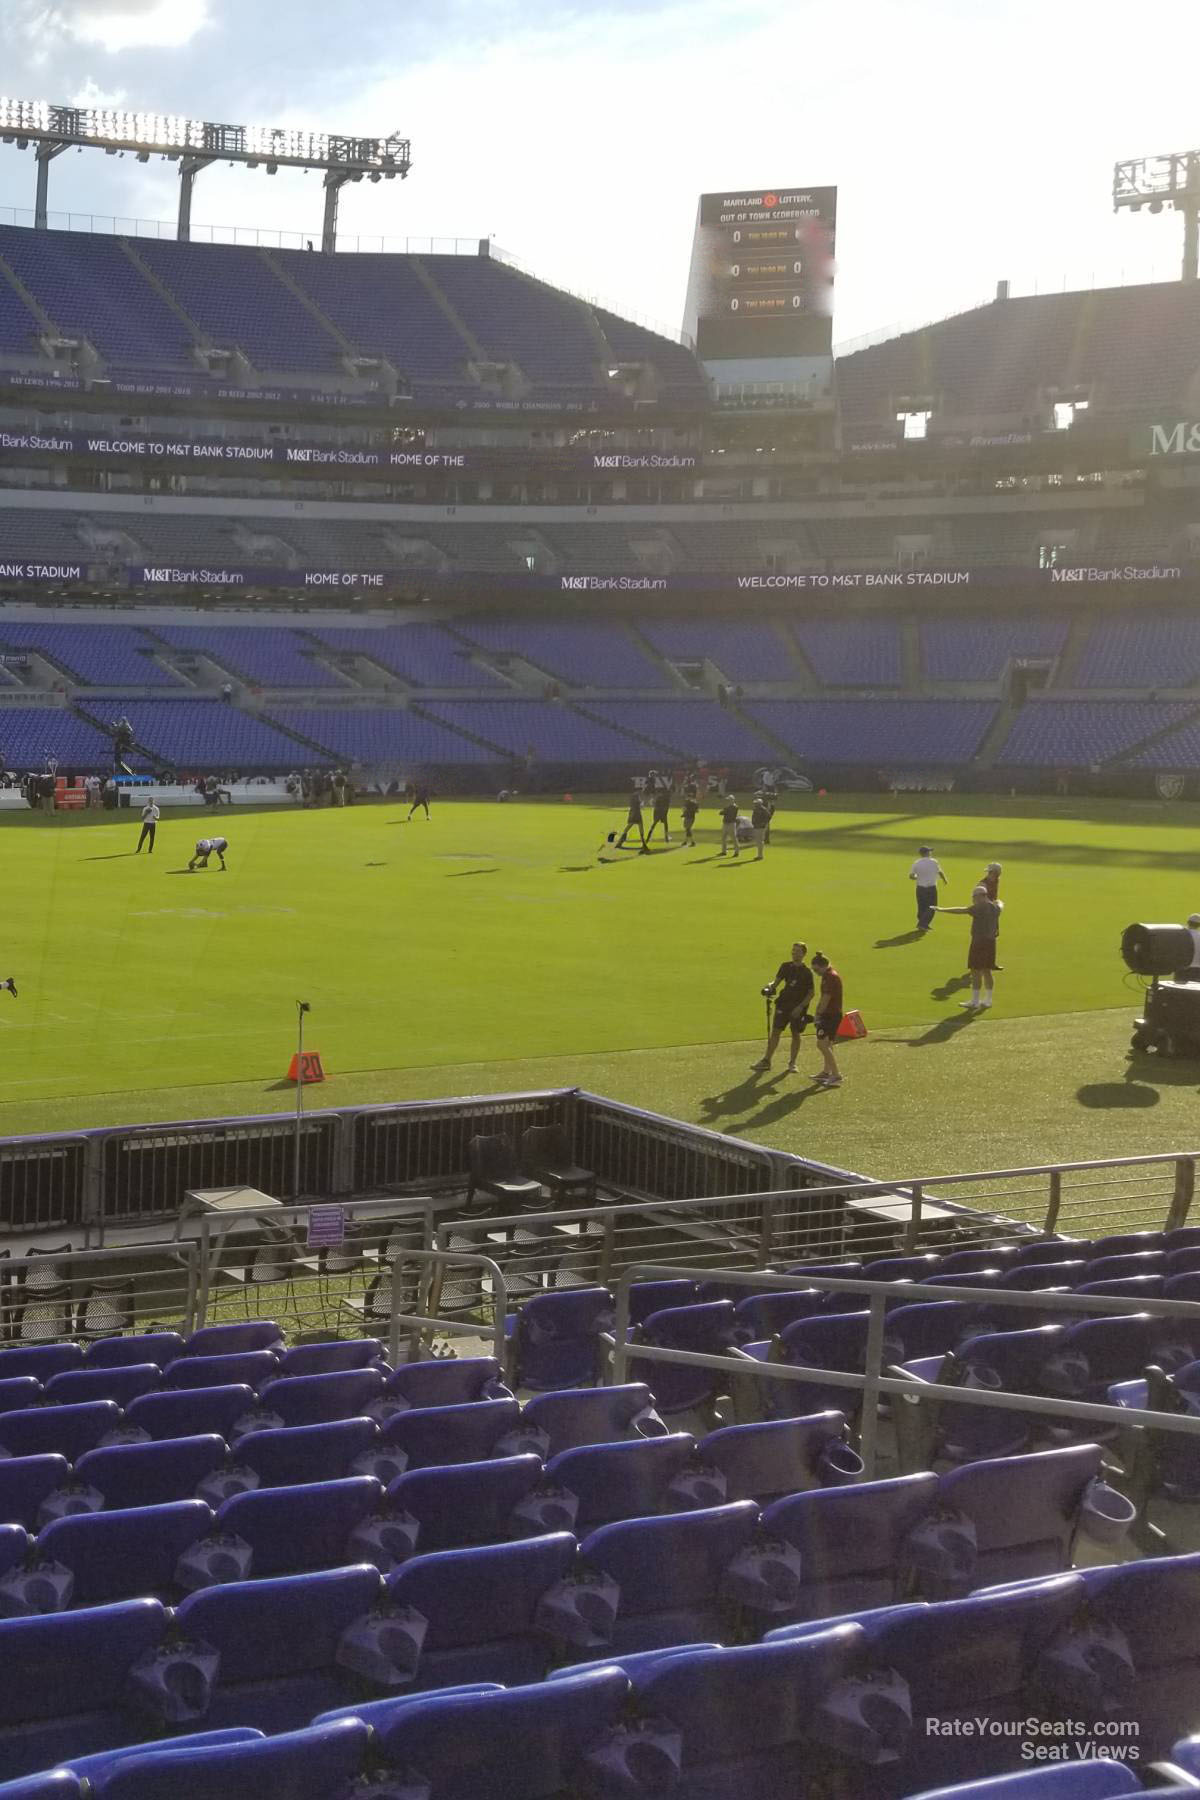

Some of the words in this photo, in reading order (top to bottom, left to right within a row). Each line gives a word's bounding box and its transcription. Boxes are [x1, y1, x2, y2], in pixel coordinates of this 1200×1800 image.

[723, 198, 762, 207] MARYLAND
[720, 215, 736, 223] OUT
[738, 214, 747, 222] OF
[750, 212, 770, 220] TOWN
[2, 434, 29, 448] Bank
[30, 436, 73, 450] Stadium
[88, 440, 145, 454] WELCOME
[149, 443, 164, 455] TO
[167, 444, 190, 456] M&T
[193, 446, 223, 458] BANK
[226, 446, 273, 459] STADIUM
[287, 449, 312, 462] M&T
[313, 450, 338, 463] Bank
[339, 451, 378, 465] Stadium
[390, 453, 421, 466] HOME
[424, 455, 440, 466] OF
[443, 456, 464, 467] THE
[594, 456, 622, 468] M&T
[622, 456, 649, 467] Bank
[650, 456, 695, 468] Stadium
[27, 565, 80, 579] STADIUM
[144, 568, 171, 582] M&T
[172, 569, 199, 583] Bank
[200, 570, 243, 584] Stadium
[305, 573, 339, 585] HOME
[342, 574, 358, 585] OF
[361, 574, 383, 586] THE
[1051, 568, 1087, 582] M&T
[1088, 567, 1122, 582] Bank
[1123, 565, 1181, 581] Stadium
[561, 576, 590, 589] M&T
[590, 576, 618, 589] Bank
[619, 577, 667, 590] Stadium
[738, 576, 806, 588] WELCOME
[810, 575, 829, 587] TO
[832, 574, 862, 586] M&T
[865, 573, 903, 586] BANK
[906, 572, 969, 585] STADIUM
[300, 1055, 323, 1079] 20
